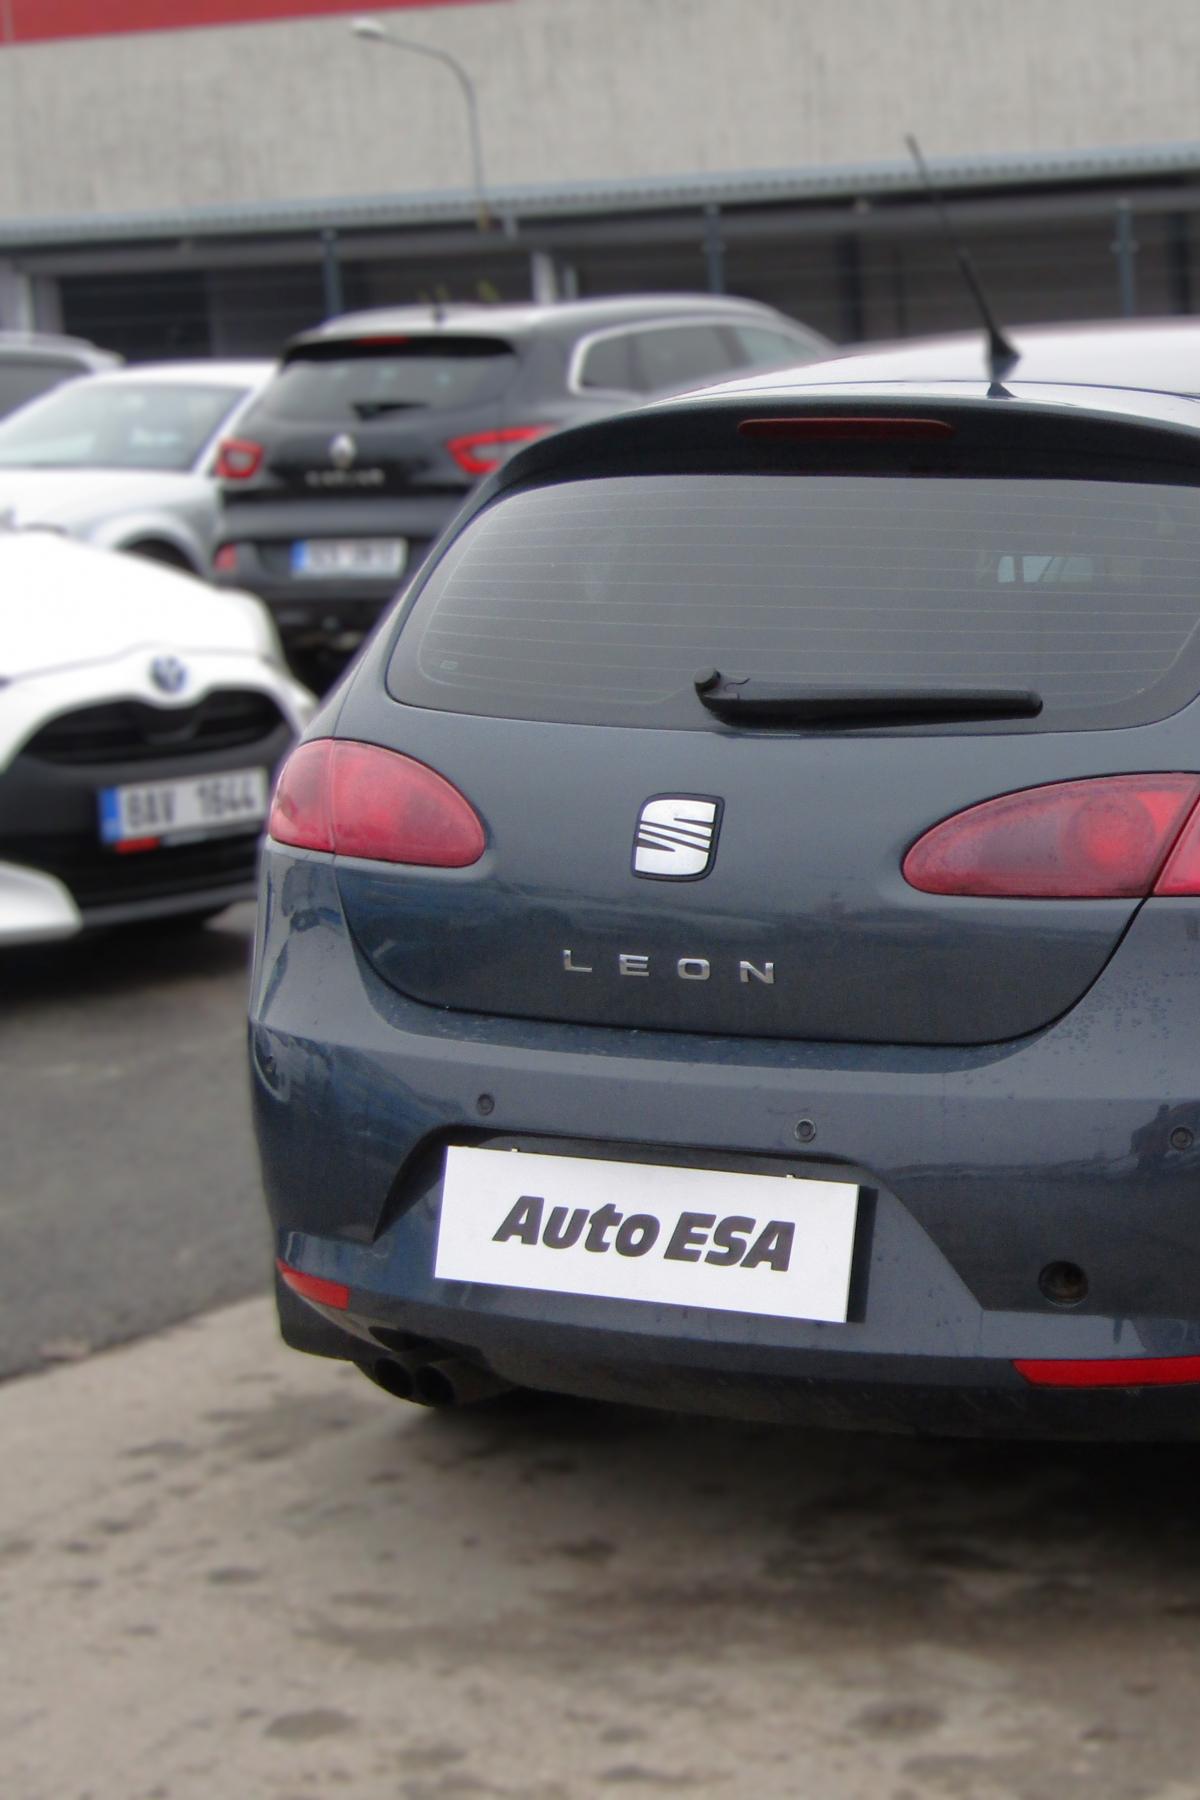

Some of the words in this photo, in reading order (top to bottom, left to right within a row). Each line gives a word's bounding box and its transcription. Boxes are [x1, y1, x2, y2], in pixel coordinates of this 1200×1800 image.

[562, 949, 775, 984] LEON
[491, 1195, 661, 1258] Auto
[663, 1211, 796, 1272] ESA
